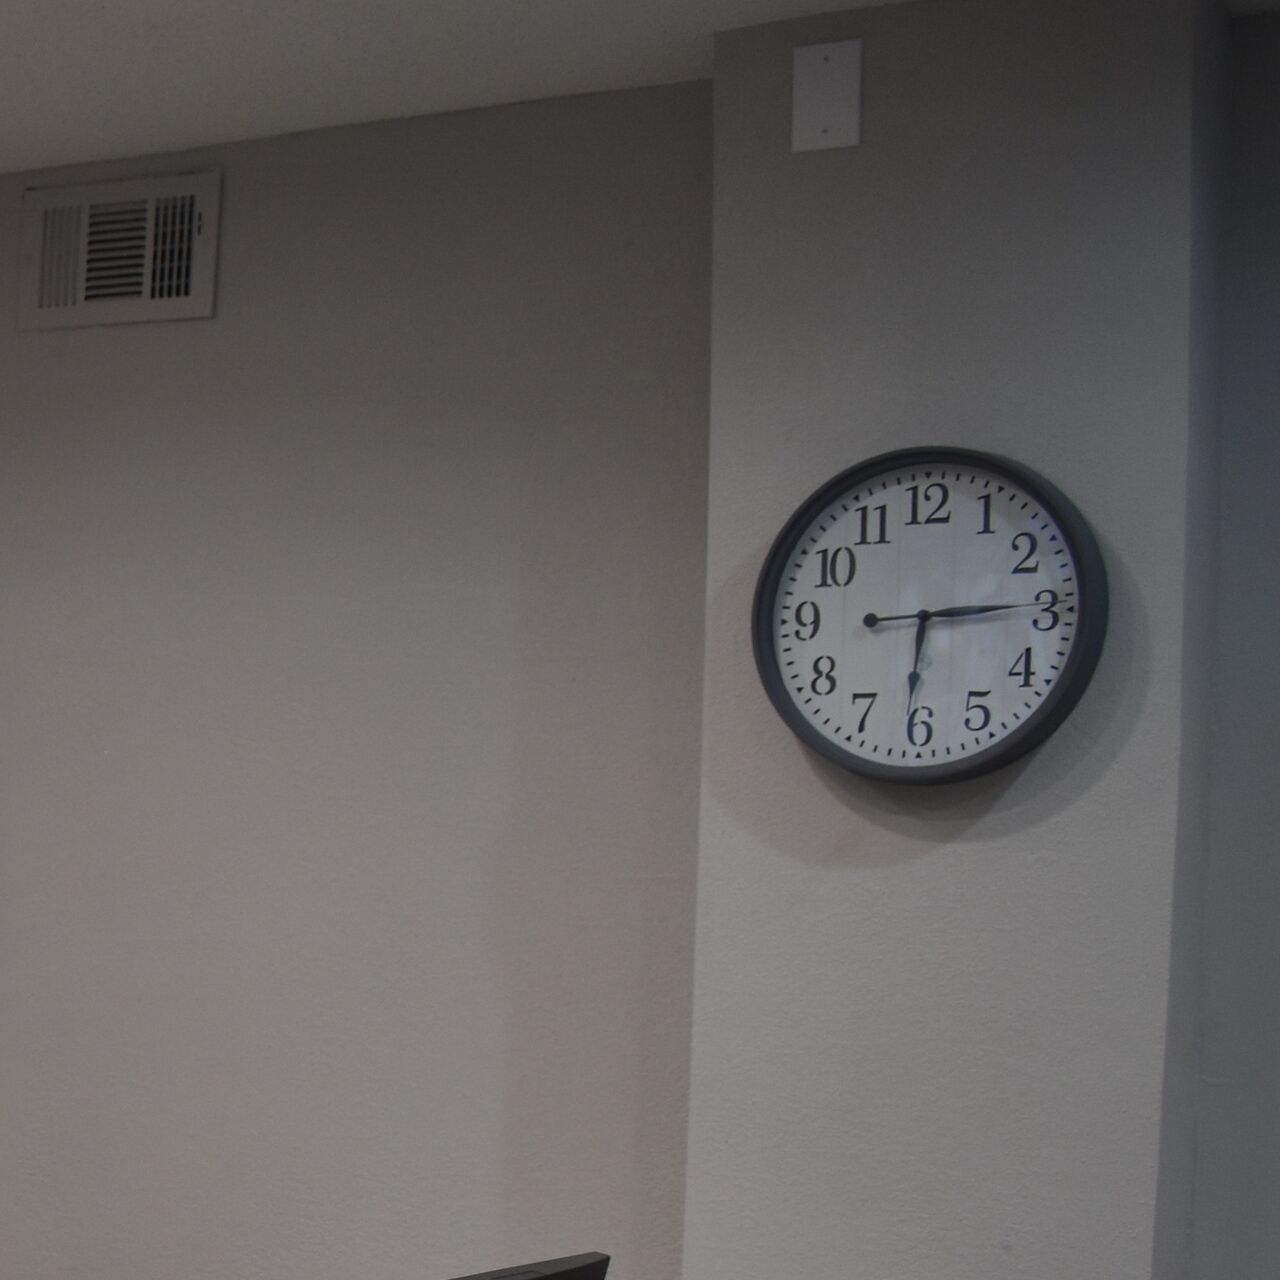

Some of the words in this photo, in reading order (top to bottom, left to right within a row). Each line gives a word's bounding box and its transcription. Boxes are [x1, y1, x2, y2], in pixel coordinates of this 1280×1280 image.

[854, 504, 892, 546] 11
[905, 483, 952, 525] 12
[976, 493, 996, 535] 1
[814, 546, 856, 588] 10
[1011, 532, 1040, 574] 2
[794, 601, 821, 641] 9
[1032, 589, 1060, 631] 3
[810, 655, 837, 696] 8
[1007, 647, 1036, 688] 4
[851, 692, 879, 734] 7
[906, 706, 934, 747] 6
[964, 690, 992, 732] 5
